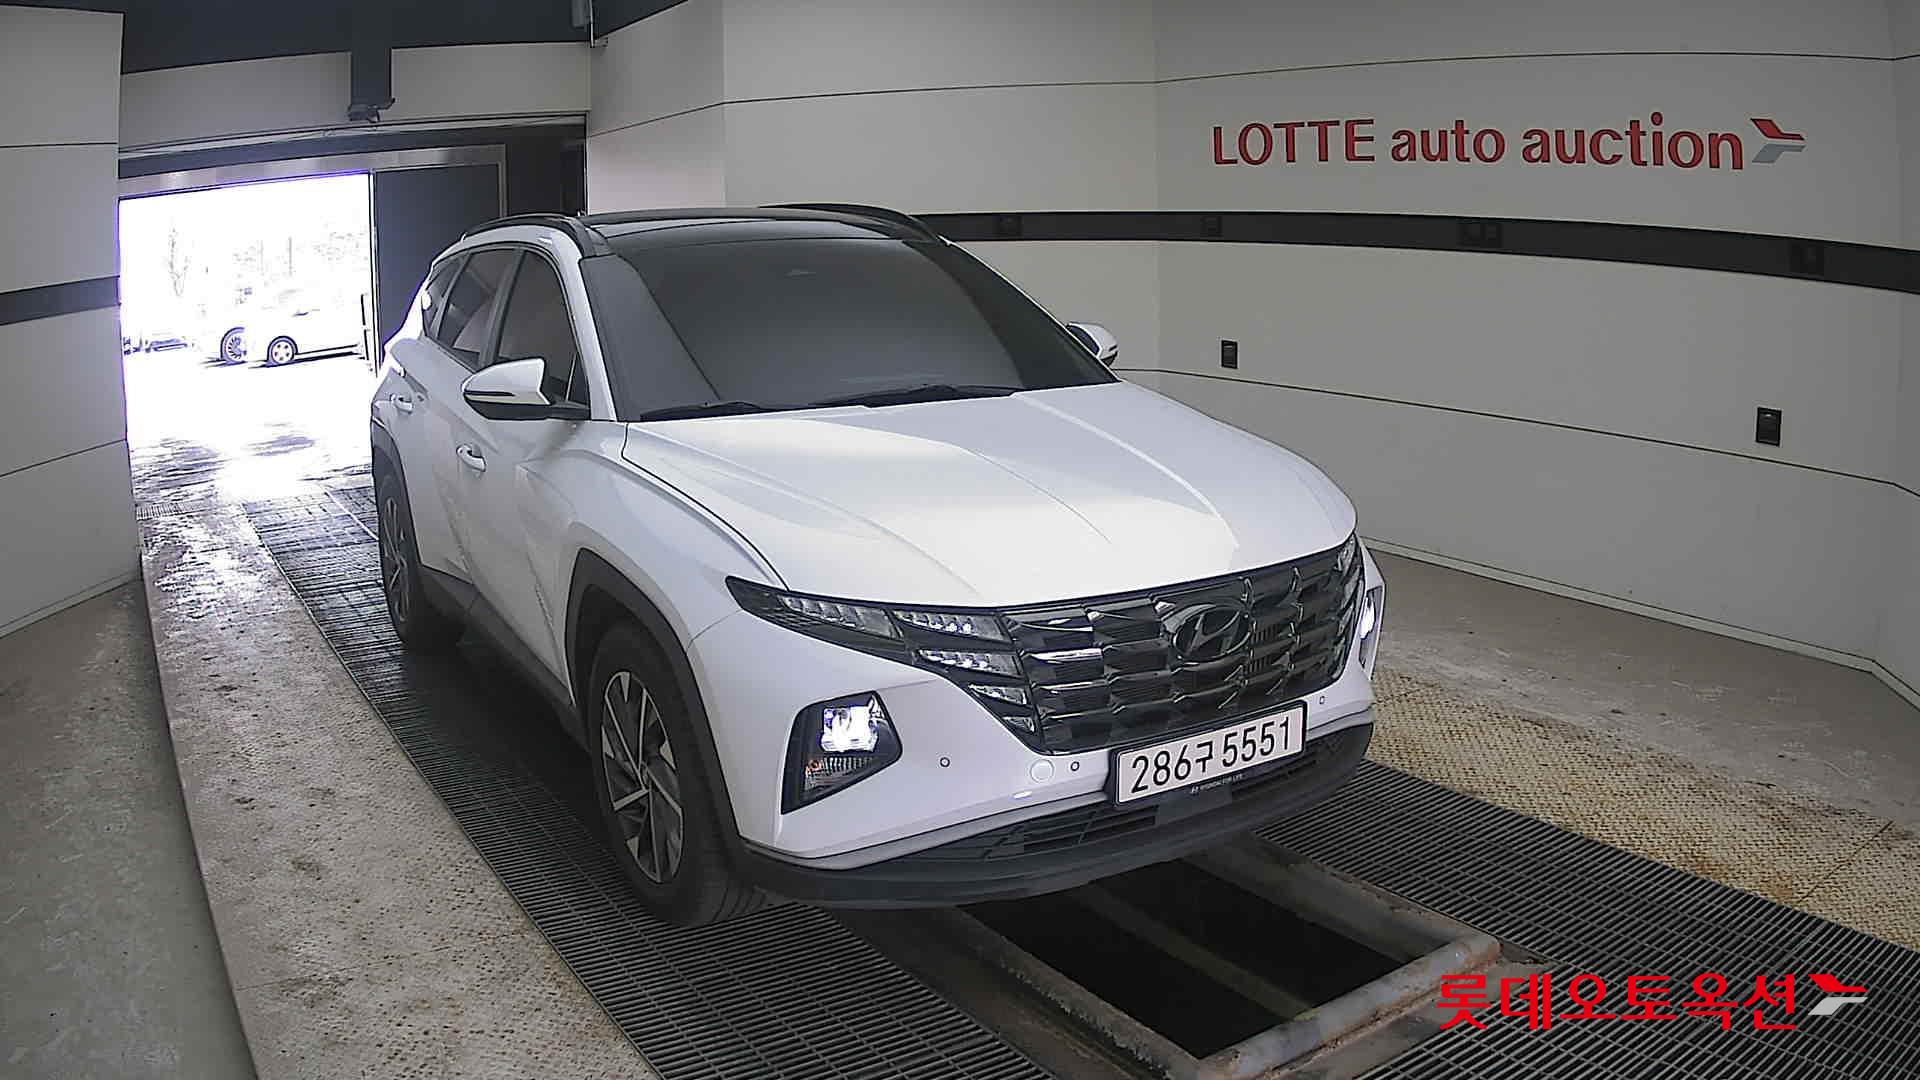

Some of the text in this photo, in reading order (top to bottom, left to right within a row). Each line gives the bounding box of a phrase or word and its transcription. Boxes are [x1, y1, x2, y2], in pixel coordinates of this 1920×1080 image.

[1212, 111, 1744, 170] LOTTE auto auction
[1131, 716, 1290, 793] 286구 5551
